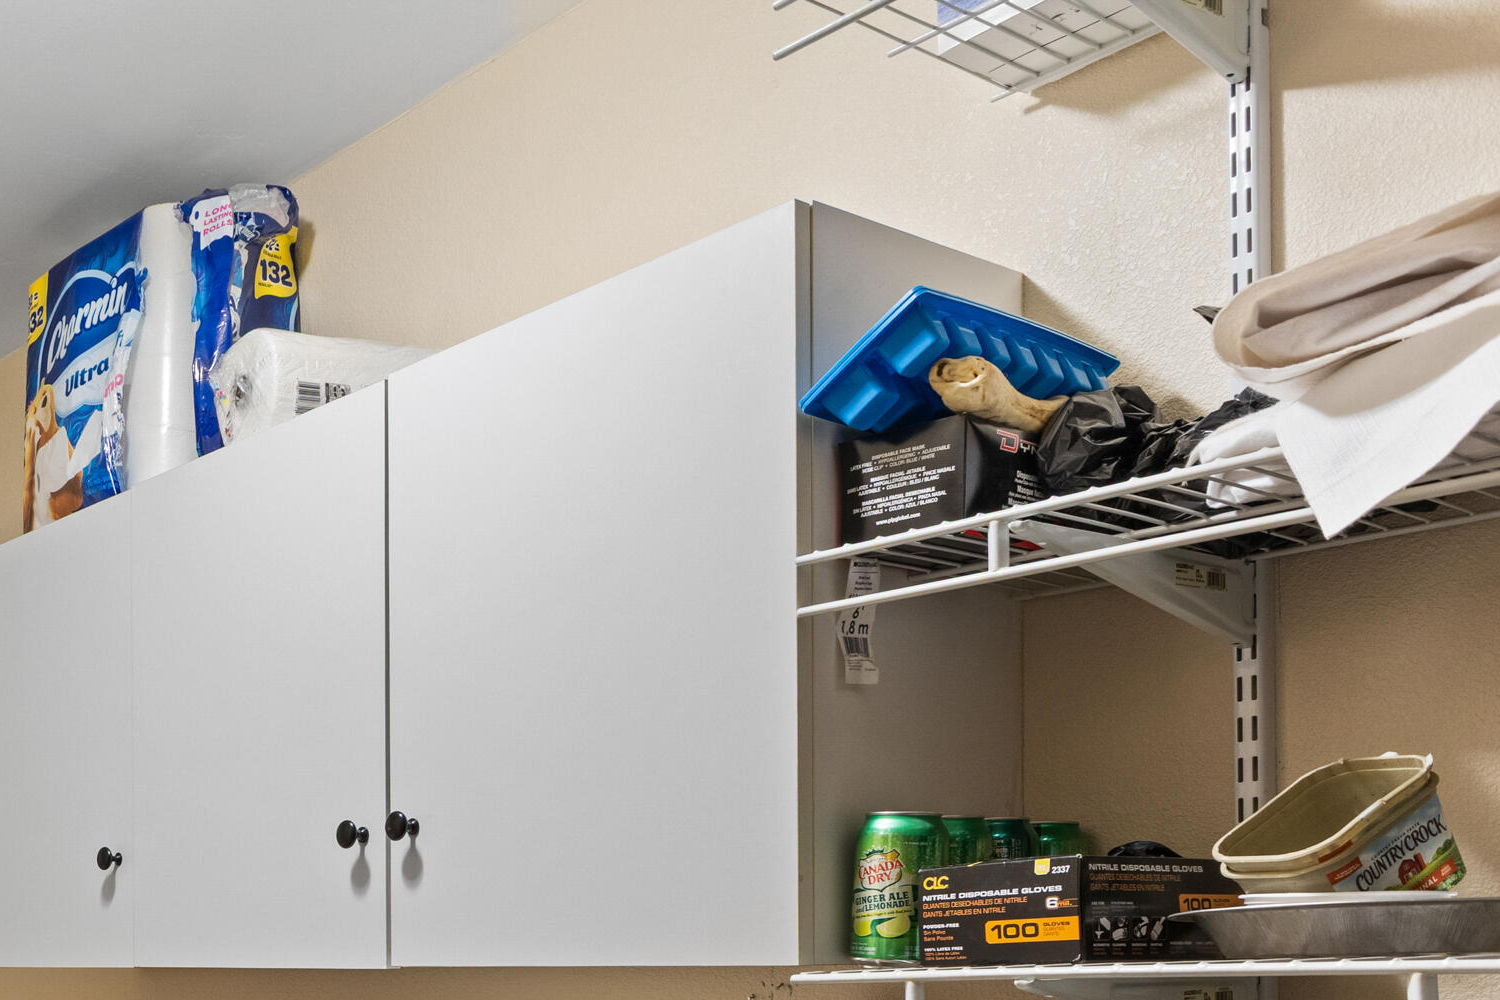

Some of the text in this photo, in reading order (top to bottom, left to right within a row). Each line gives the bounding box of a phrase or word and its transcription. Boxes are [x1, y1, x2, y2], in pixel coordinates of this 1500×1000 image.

[203, 219, 233, 237] ROLLS
[260, 258, 293, 288] 132
[47, 277, 128, 374] Charmin
[65, 357, 109, 397] Ultra
[871, 449, 898, 460] DISPOSABLE
[858, 624, 869, 635] m
[1355, 813, 1447, 892] COUNTRY CROCK
[858, 858, 905, 880] CANADA
[1051, 865, 1070, 874] 2337
[1120, 864, 1171, 872] DISPOSABLE
[1172, 865, 1204, 873] GLOVES
[868, 871, 893, 885] DRY
[923, 875, 949, 891] CLC
[855, 891, 910, 906] GINGER ALE
[922, 885, 1063, 902] NITRILE DISPOSABLE GLOVES
[865, 899, 911, 912] LEMONADE
[923, 898, 1002, 910] GUANTES DESECHABLES DE
[1183, 898, 1212, 912] 100
[922, 910, 943, 918] GANTS
[943, 908, 973, 917] JETABLES
[973, 907, 982, 915] EN
[983, 906, 1006, 914] NITRILE
[990, 922, 1039, 940] 100
